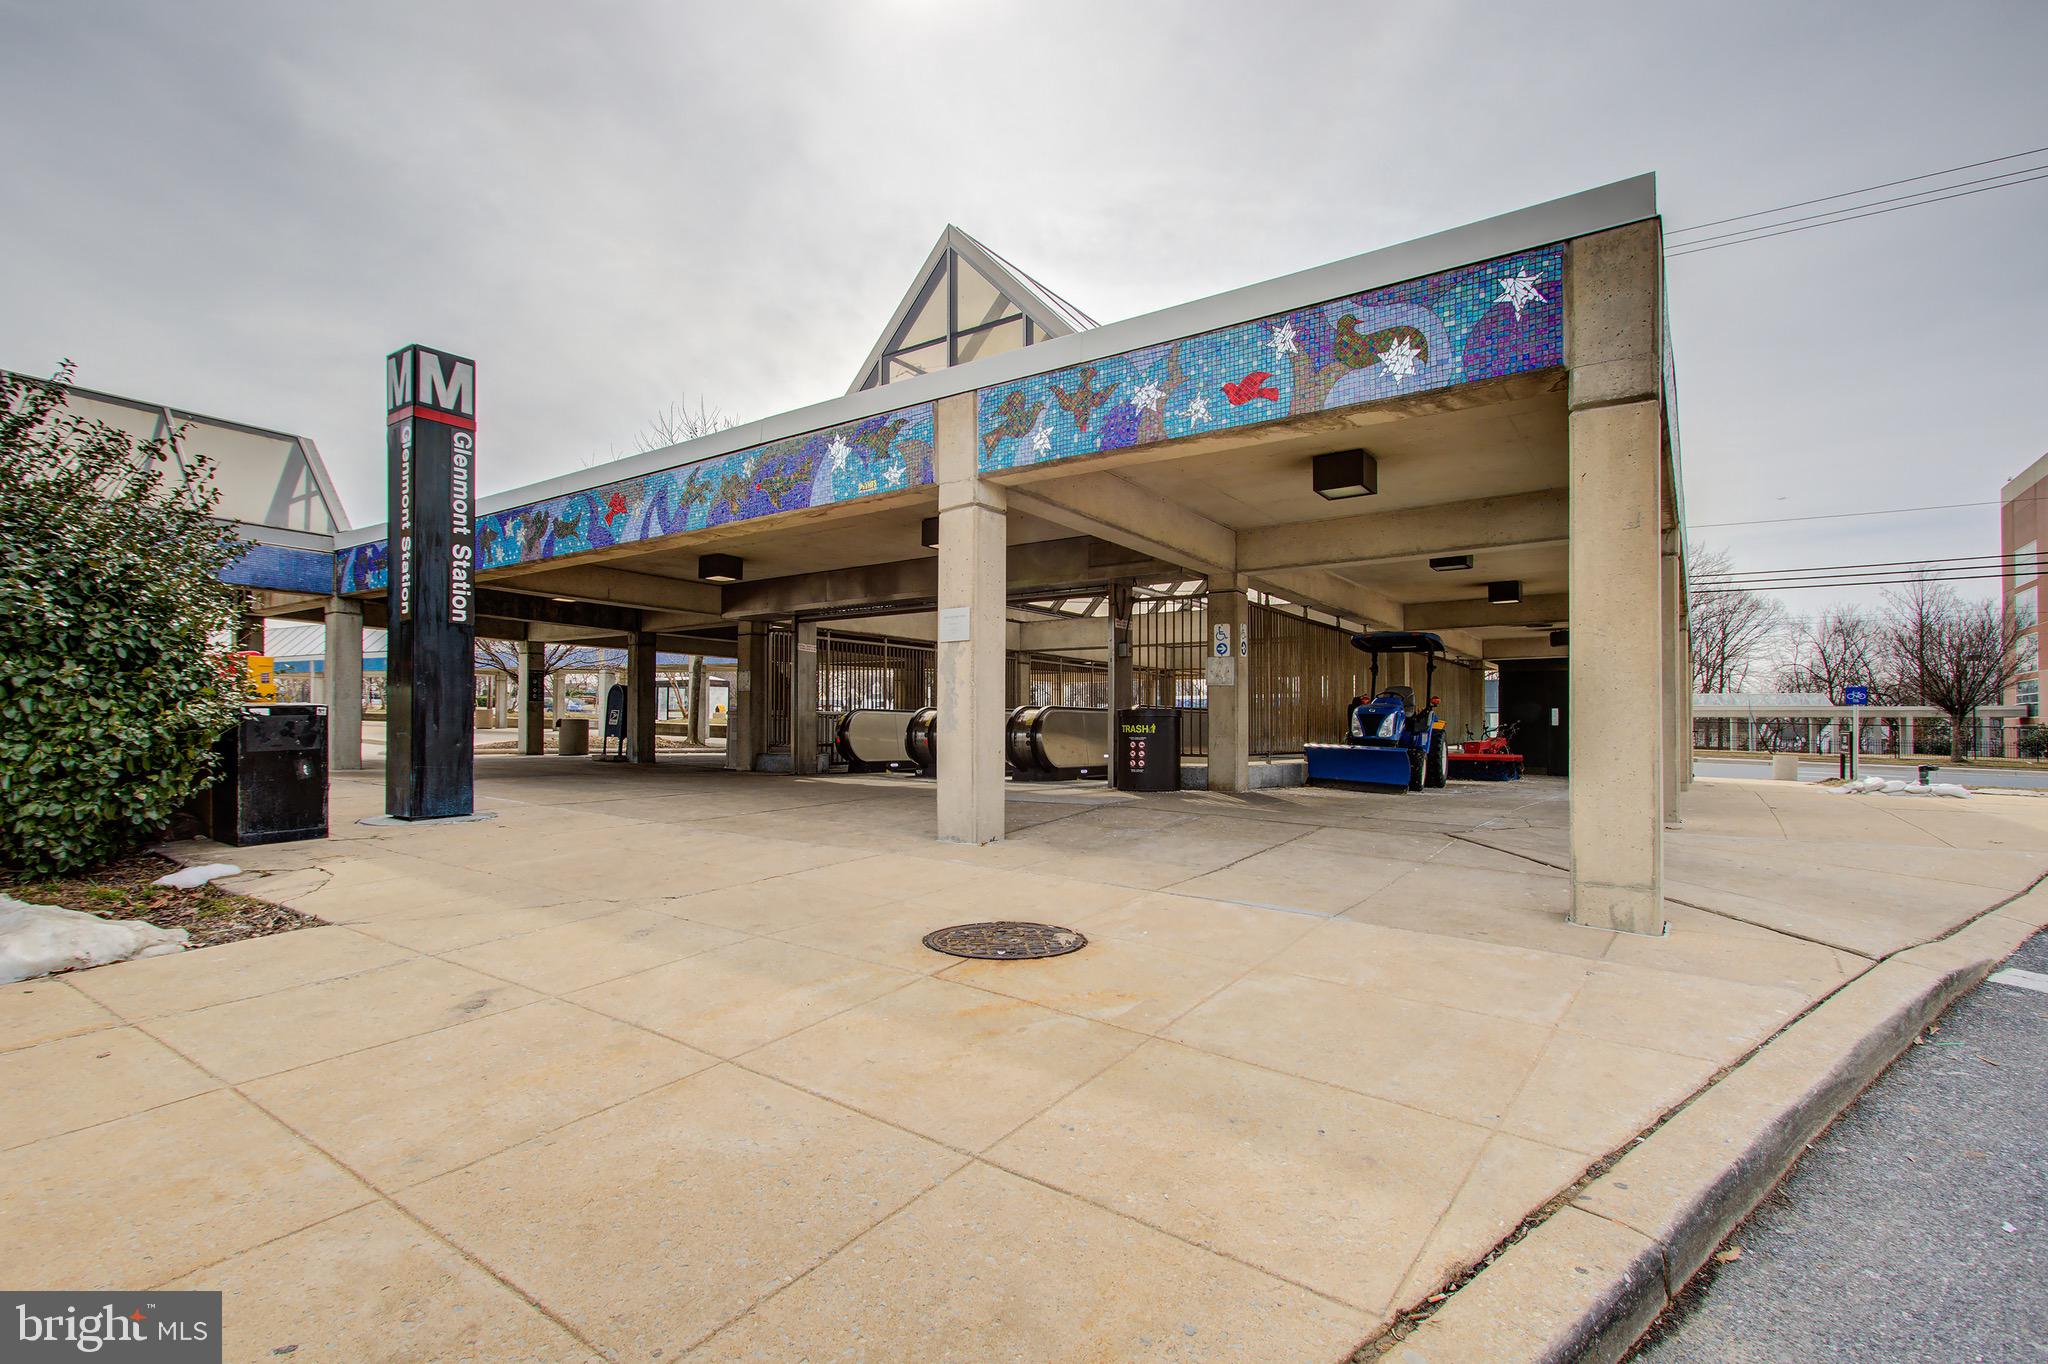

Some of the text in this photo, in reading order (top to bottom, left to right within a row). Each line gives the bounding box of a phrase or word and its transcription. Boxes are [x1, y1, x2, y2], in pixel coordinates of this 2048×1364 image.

[387, 350, 412, 411] M
[418, 350, 473, 415] M
[401, 426, 412, 614] Glenmont Station
[451, 431, 473, 622] Glenmont Station
[1121, 724, 1149, 734] TRASH
